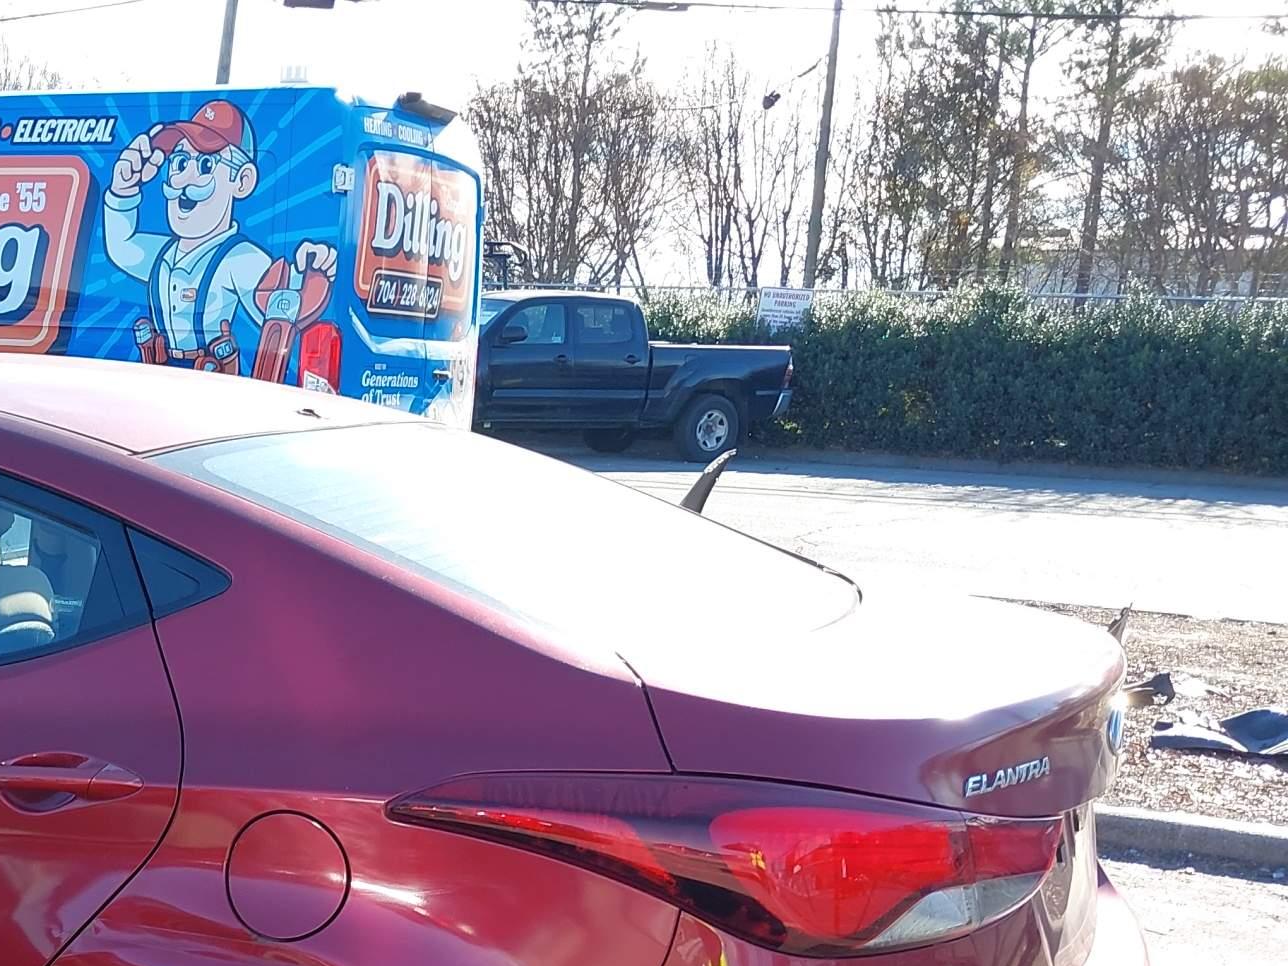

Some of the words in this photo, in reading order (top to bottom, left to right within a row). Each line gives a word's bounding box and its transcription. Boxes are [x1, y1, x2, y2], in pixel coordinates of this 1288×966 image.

[13, 118, 115, 143] ELECTRICAL
[363, 116, 393, 138] HEATING
[398, 124, 424, 145] COOLING
[371, 181, 467, 282] Dilling
[372, 276, 401, 306] (704)
[362, 370, 419, 388] Generations
[362, 388, 374, 404] of
[374, 389, 401, 406] Trust
[965, 756, 1050, 798] ELANTRA
